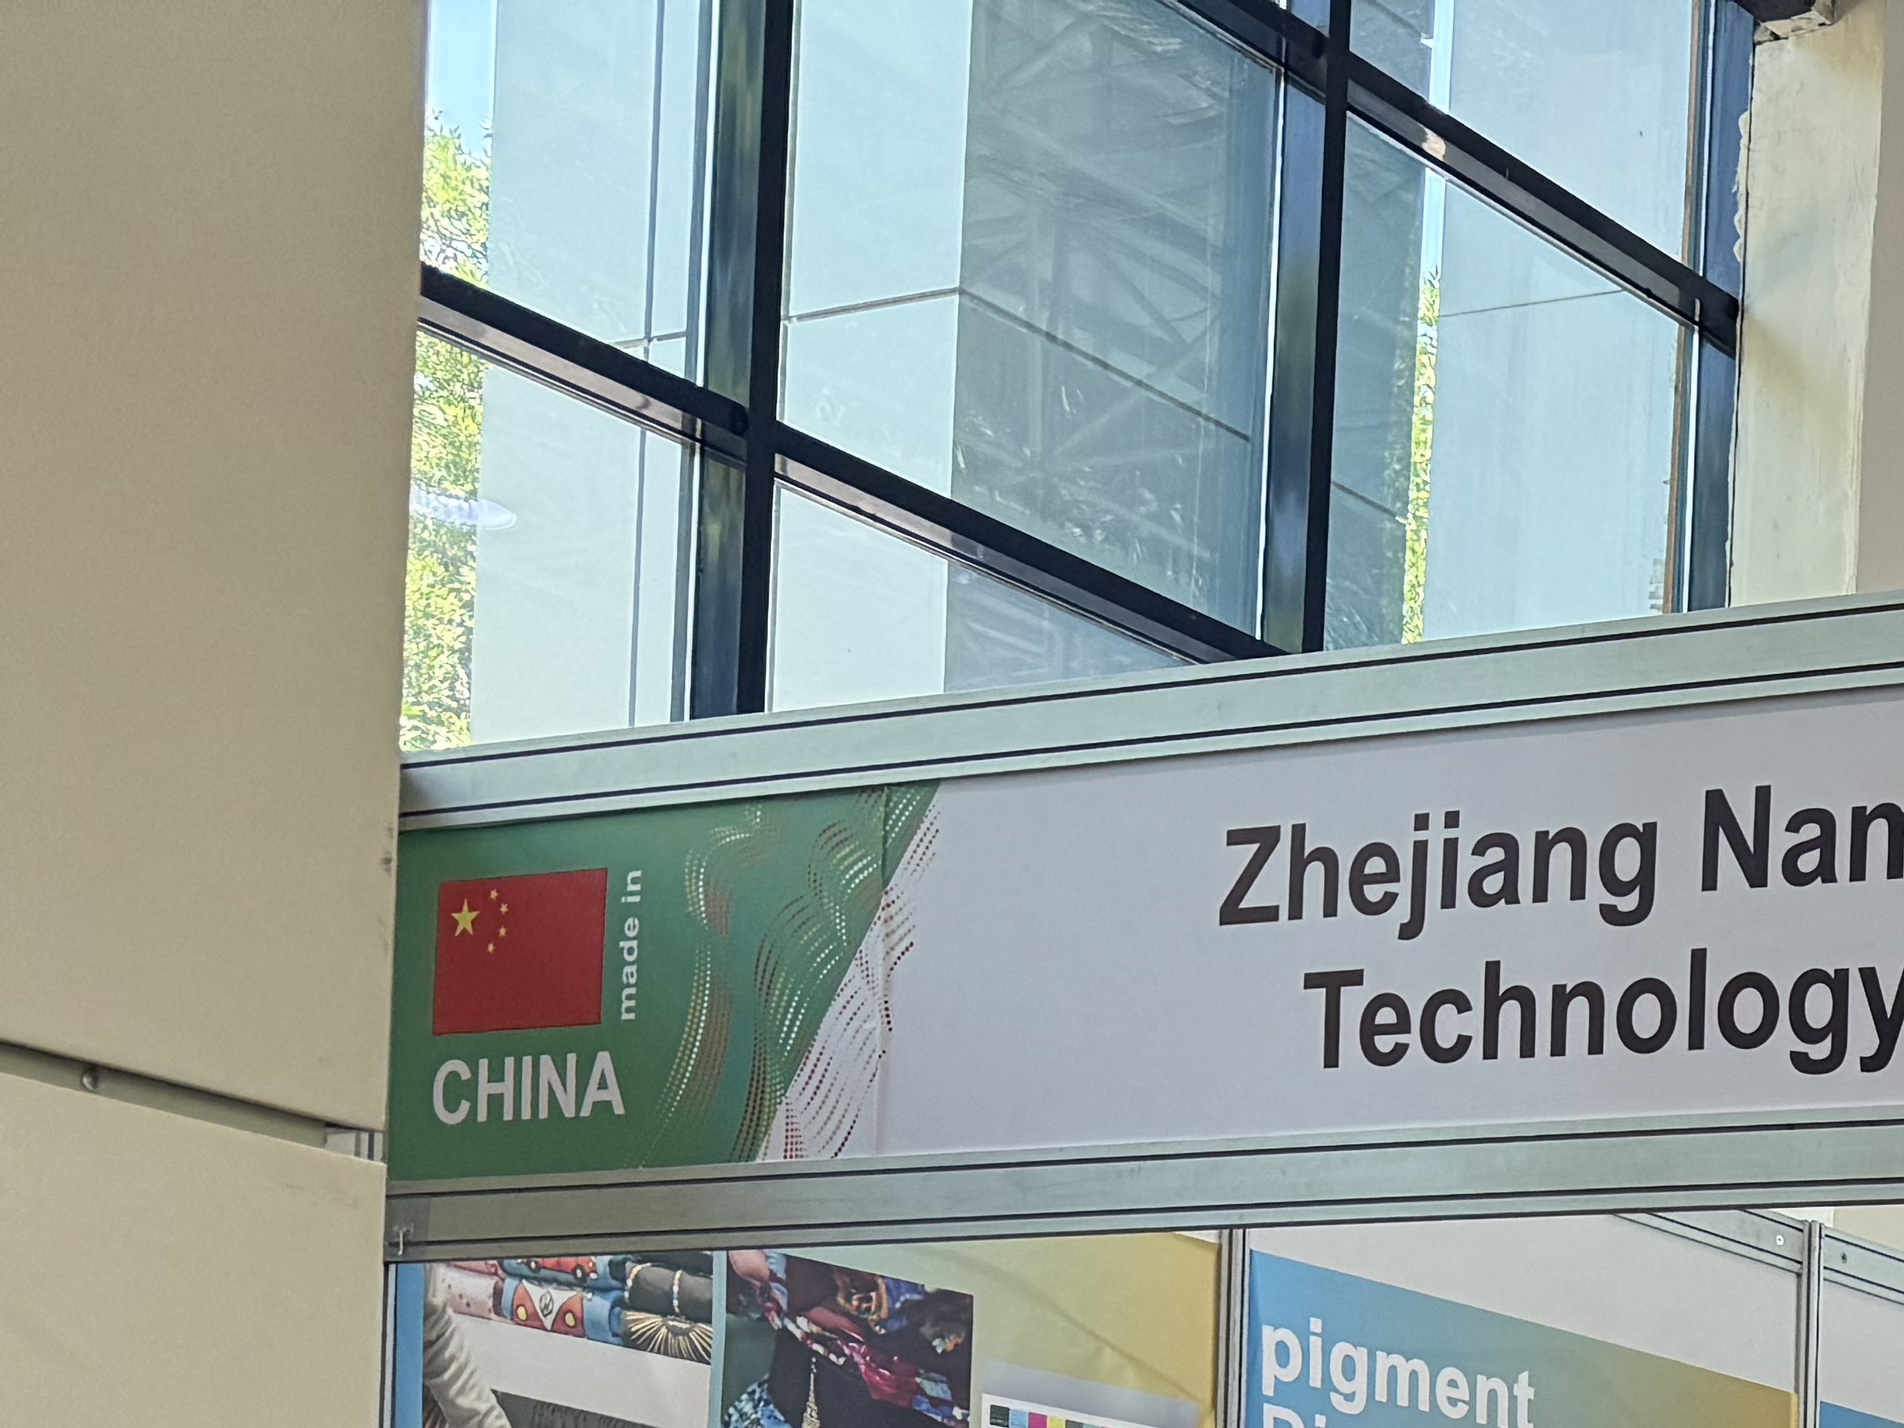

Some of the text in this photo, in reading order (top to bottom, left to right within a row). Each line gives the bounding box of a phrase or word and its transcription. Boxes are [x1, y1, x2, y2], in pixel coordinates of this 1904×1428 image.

[1218, 810, 1658, 941] Zhejiang
[620, 868, 642, 1022] made in
[431, 1050, 625, 1126] CHINA
